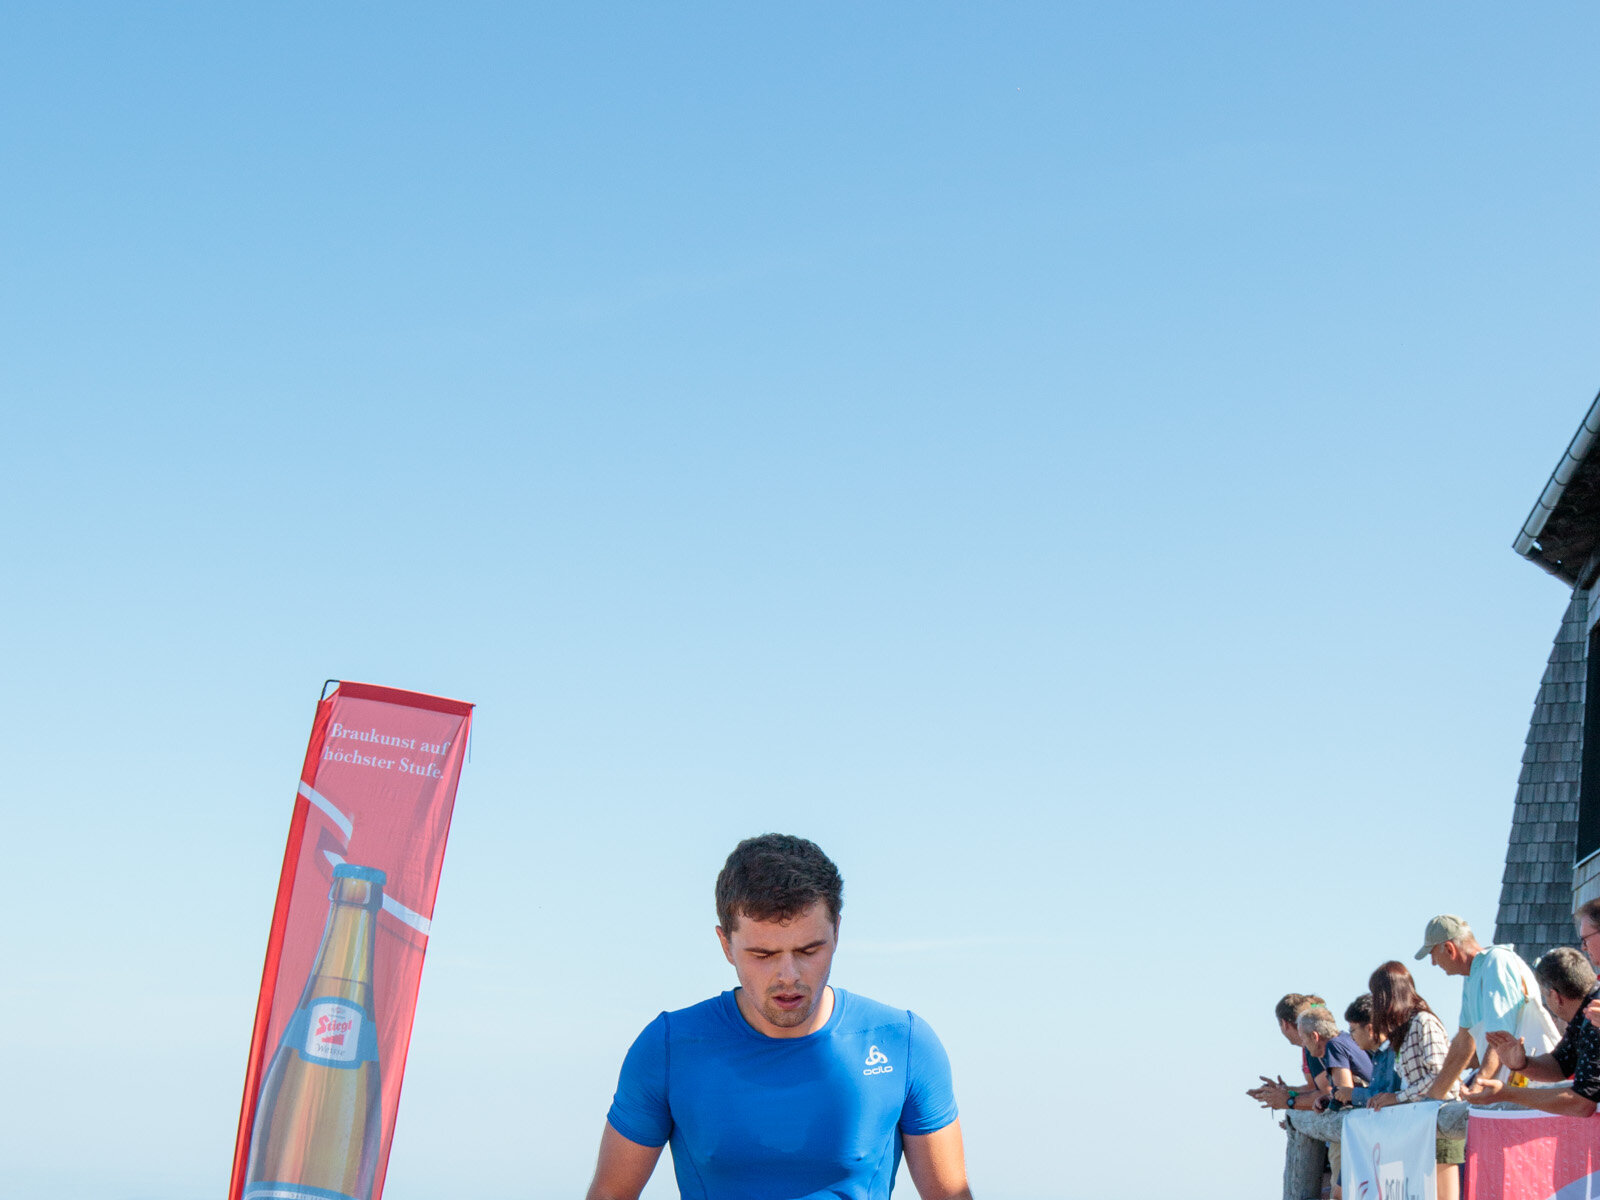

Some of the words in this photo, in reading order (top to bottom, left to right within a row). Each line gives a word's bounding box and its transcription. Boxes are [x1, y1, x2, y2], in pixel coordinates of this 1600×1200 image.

[331, 723, 416, 749] Braukunst
[420, 741, 451, 756] auf
[323, 746, 395, 769] höchster
[398, 757, 444, 779] Stufe.
[863, 1065, 893, 1075] odlo
